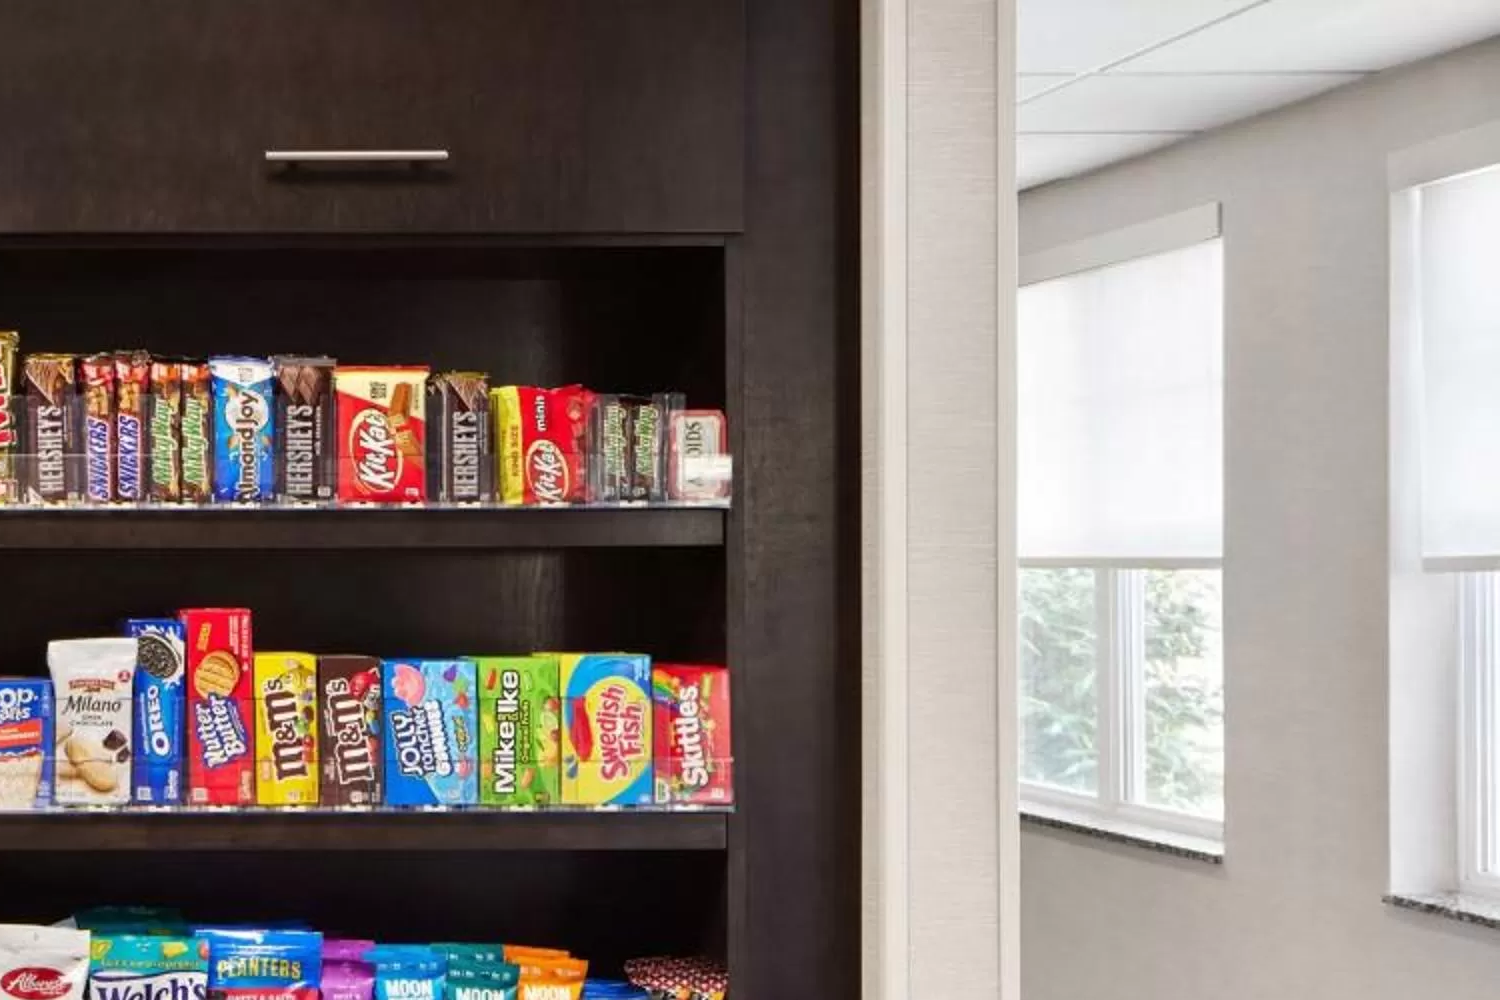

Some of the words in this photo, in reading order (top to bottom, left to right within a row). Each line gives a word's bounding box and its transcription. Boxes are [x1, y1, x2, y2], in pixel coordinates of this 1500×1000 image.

[236, 391, 259, 426] Joy
[536, 395, 546, 431] minis
[37, 405, 64, 493] HERSHEY'S
[88, 419, 109, 499] SNICKERS
[119, 415, 140, 497] SNICKERS
[236, 427, 258, 503] Almond
[286, 404, 313, 495] HERSHEY'S
[453, 411, 480, 497] HERSHEY'S
[62, 695, 122, 715] Milano
[148, 684, 170, 755] OREO
[498, 670, 519, 712] Ike
[196, 702, 229, 767] Nutter
[209, 695, 247, 757] Butter
[393, 713, 423, 776] JOLLY
[413, 707, 435, 772] rancher
[495, 721, 517, 794] Mike
[596, 685, 628, 781] Swedish
[620, 703, 644, 758] Fish
[217, 957, 301, 979] PLANTERS
[386, 979, 433, 997] MOON
[524, 984, 571, 1000] MOON
